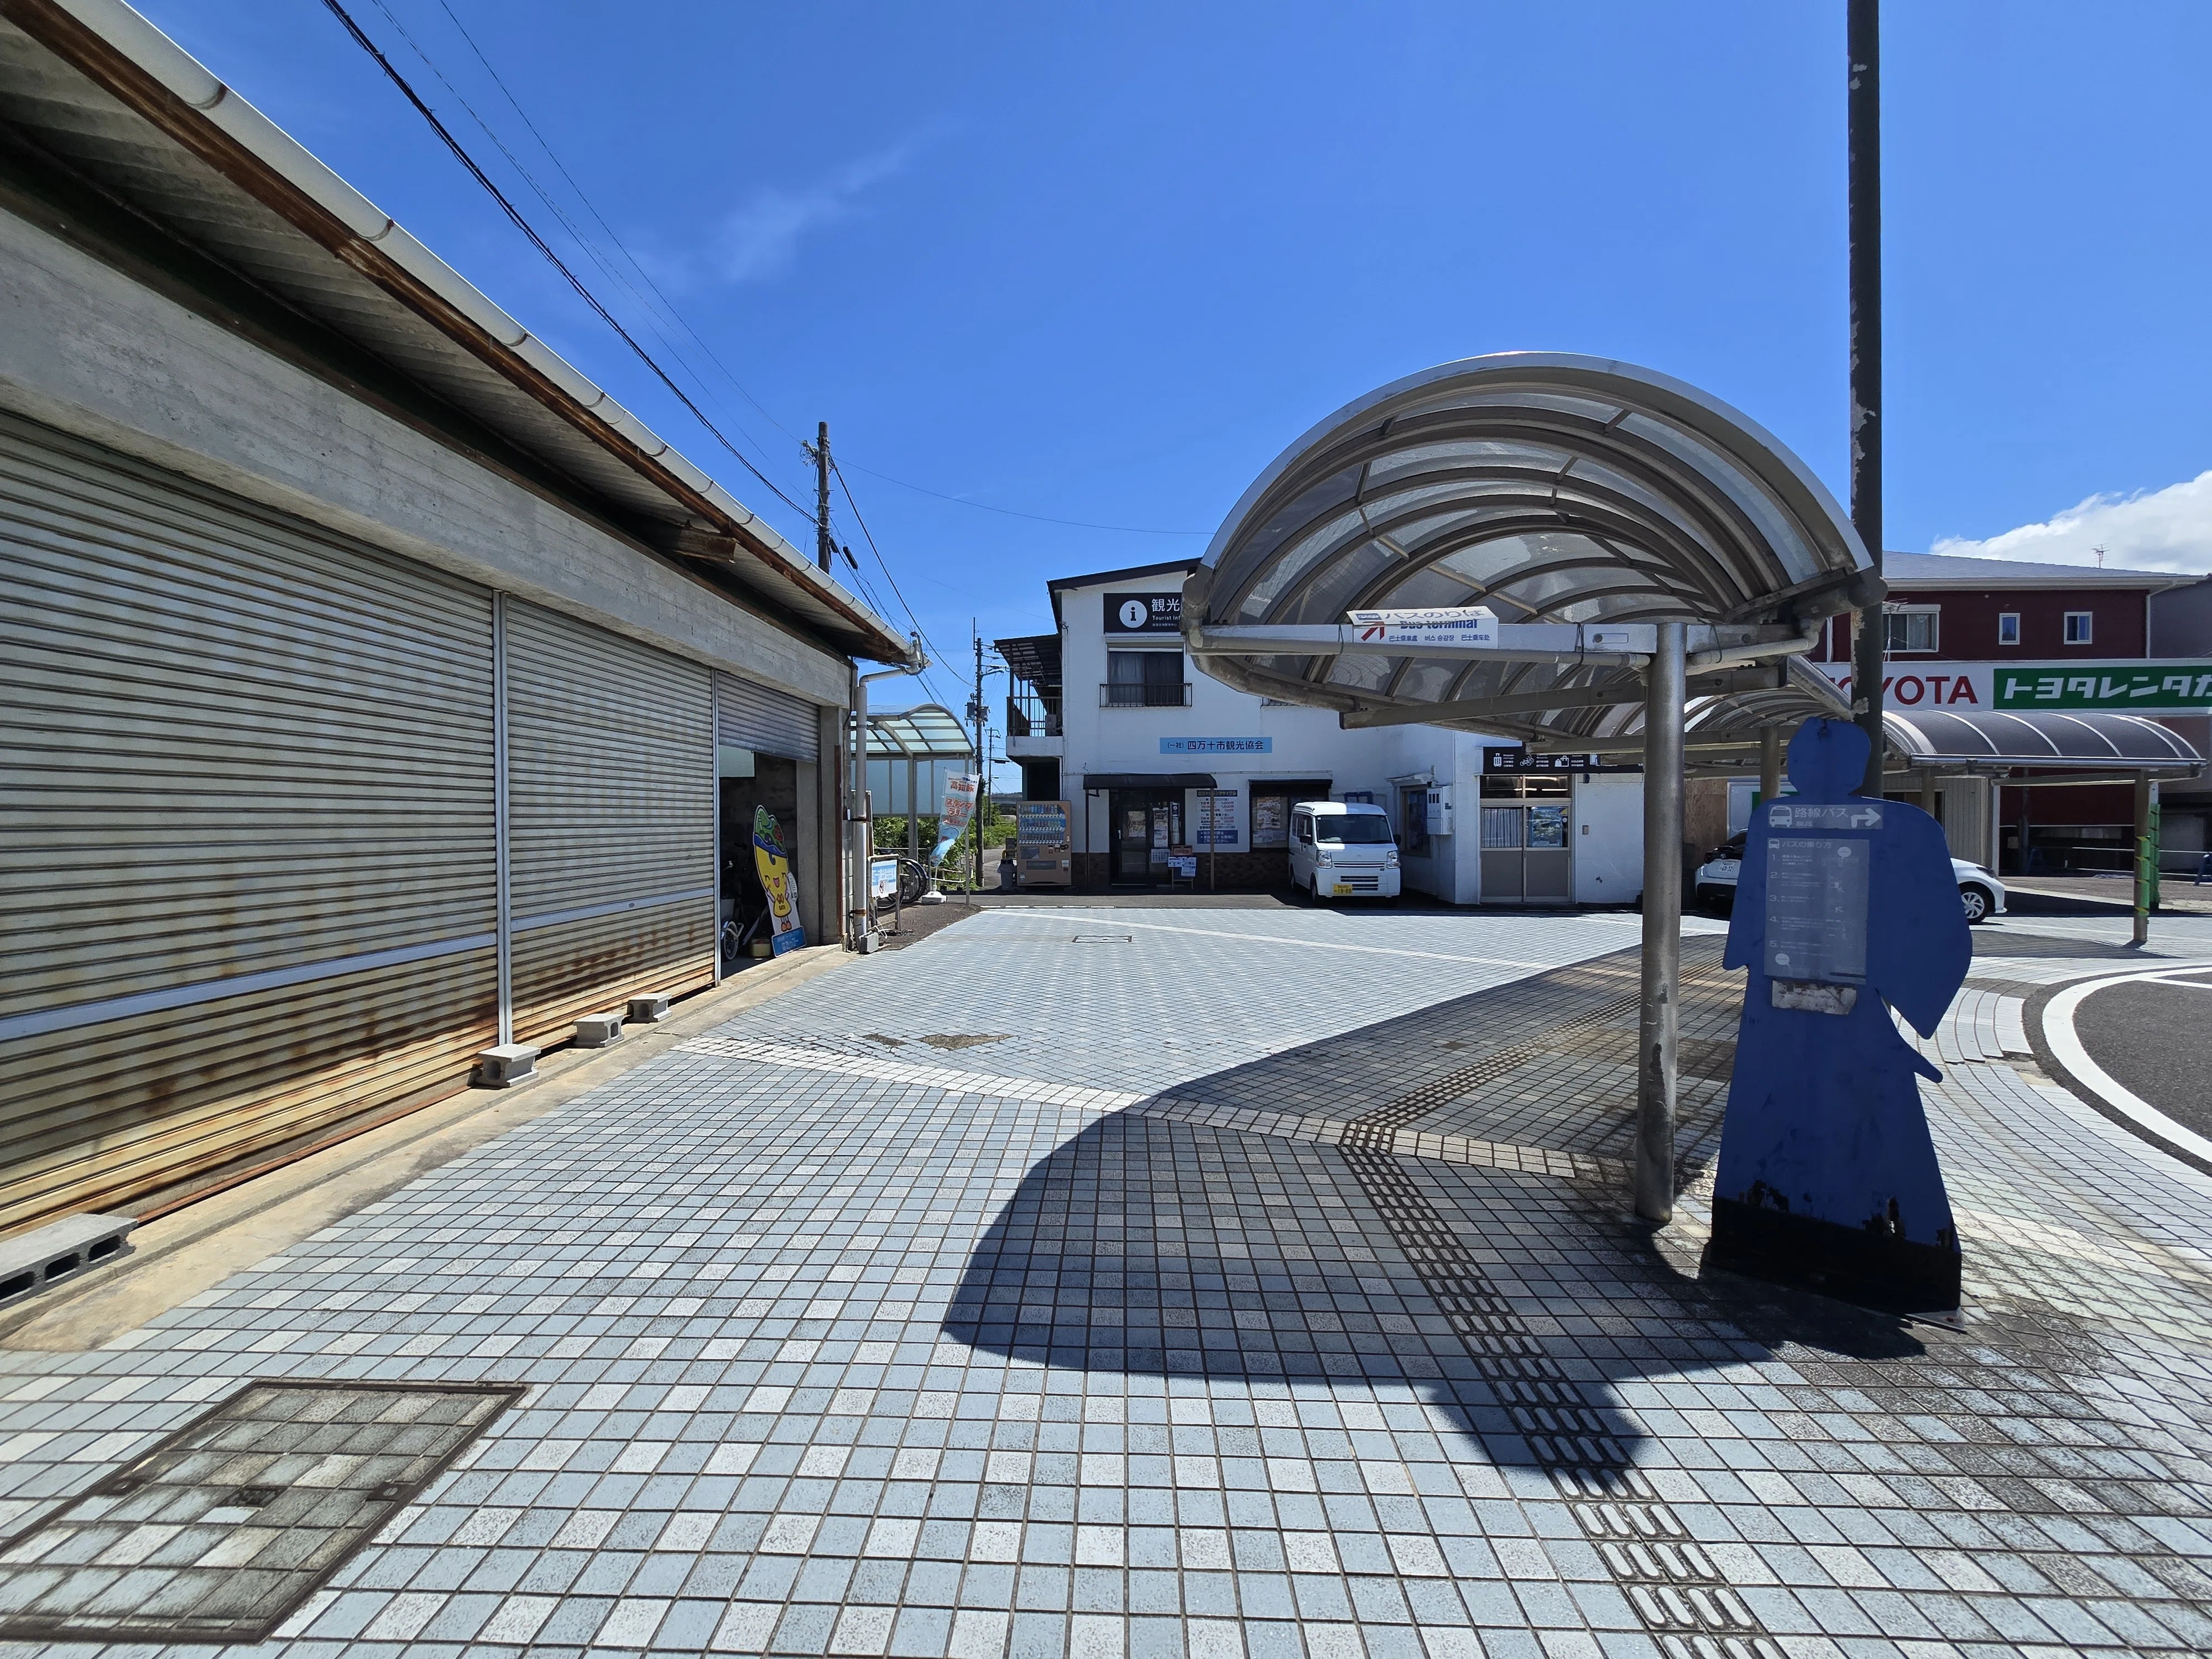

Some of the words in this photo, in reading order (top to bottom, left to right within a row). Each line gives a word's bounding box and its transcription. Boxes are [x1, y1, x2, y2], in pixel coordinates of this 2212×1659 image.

[1152, 599, 1180, 612] 観光
[1385, 609, 1484, 619] バスのりば
[1187, 740, 1264, 750] 四万十市観光協会
[946, 797, 974, 811] スタンプ
[948, 807, 968, 818] ラリー
[1794, 807, 1848, 818] 路線バス
